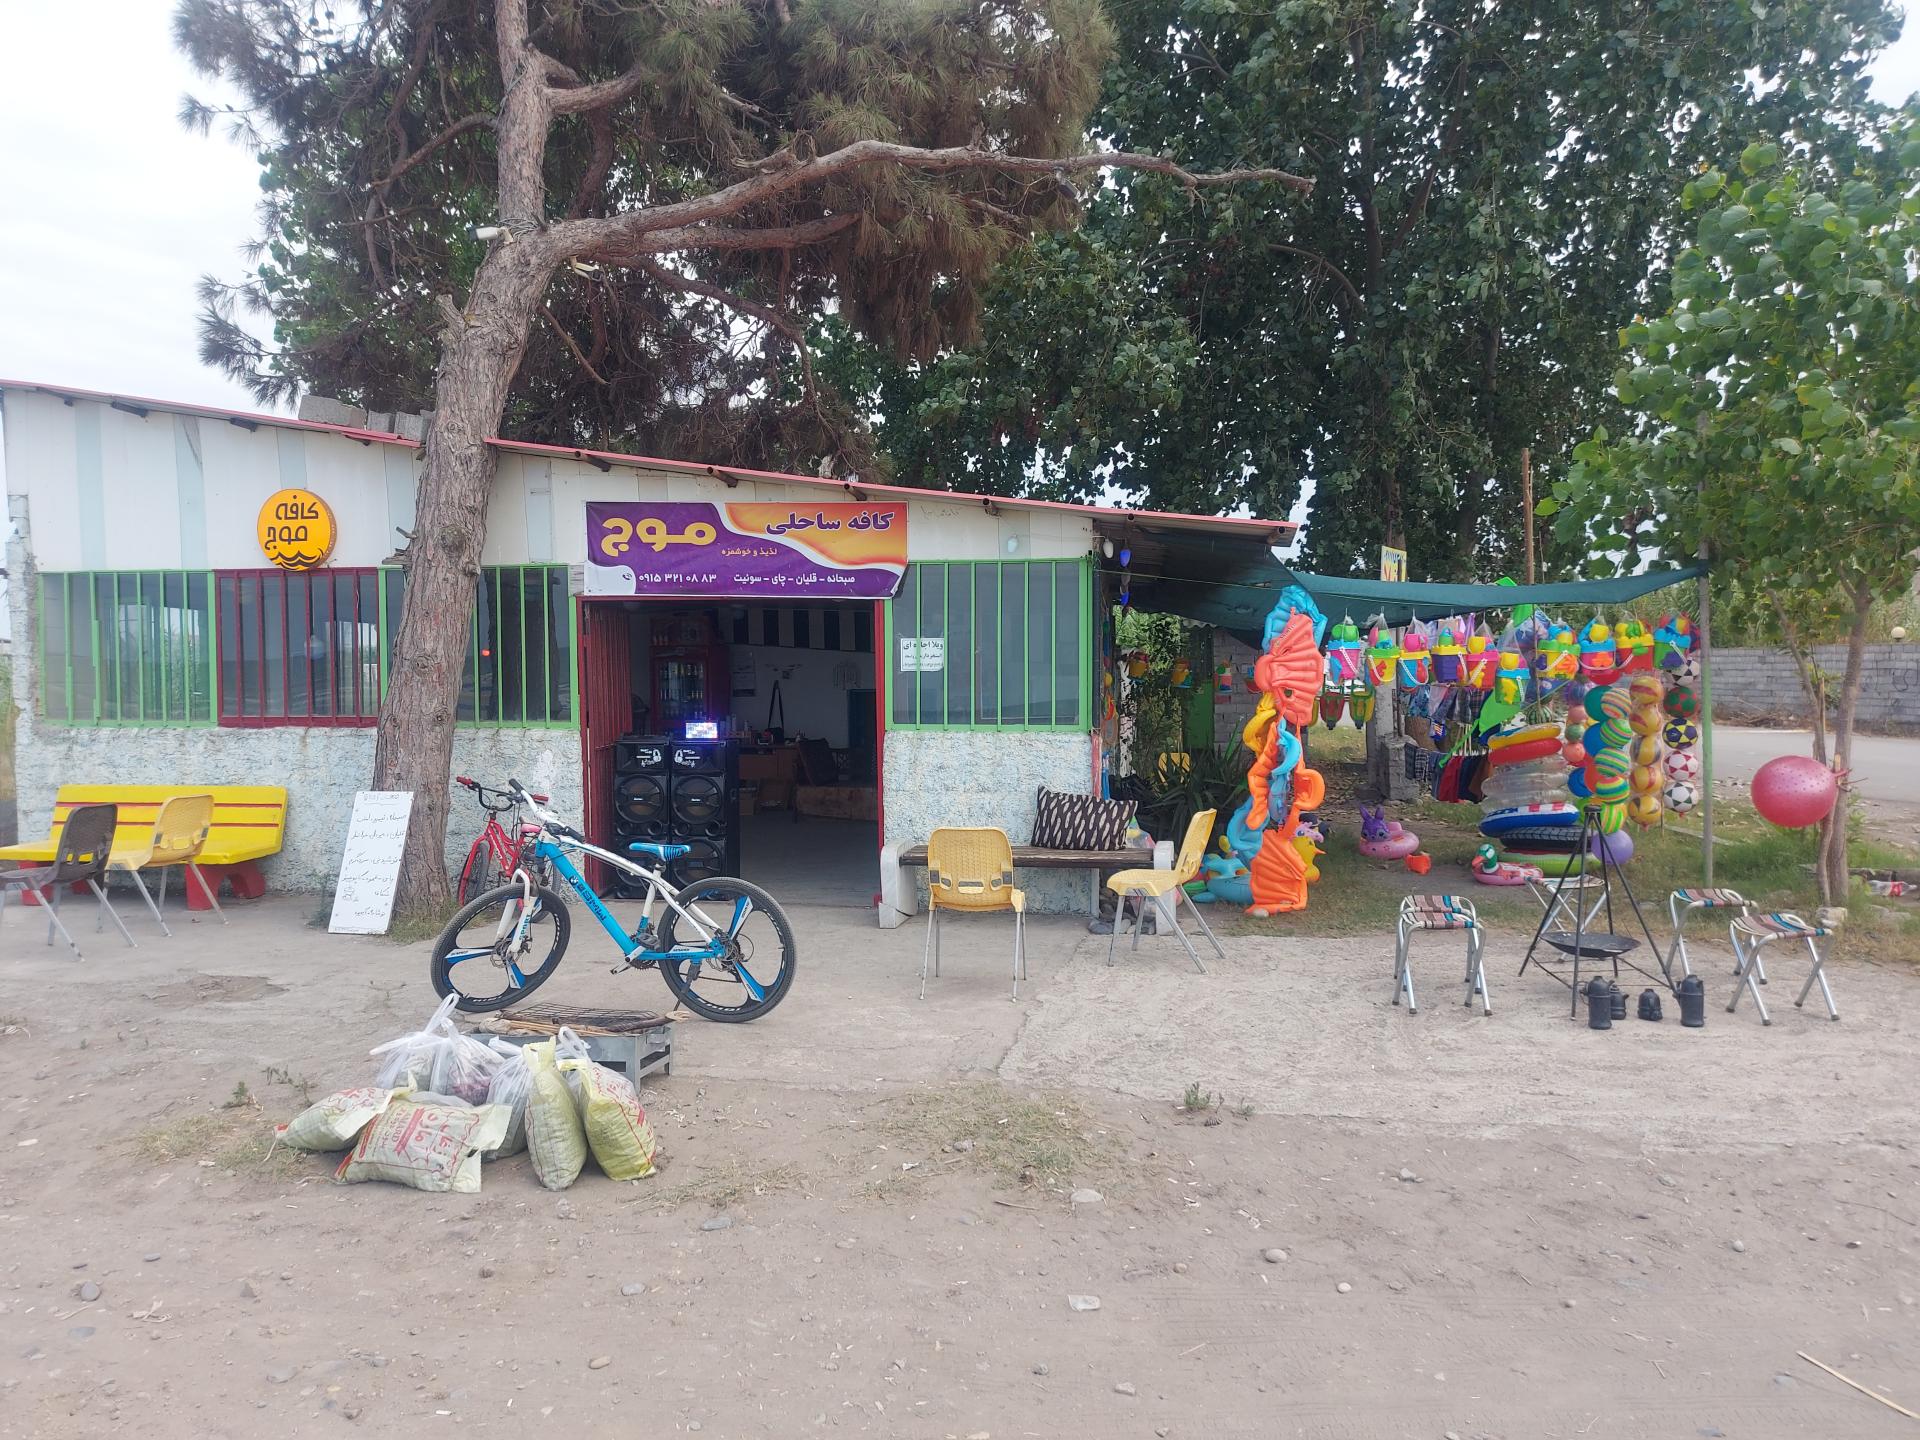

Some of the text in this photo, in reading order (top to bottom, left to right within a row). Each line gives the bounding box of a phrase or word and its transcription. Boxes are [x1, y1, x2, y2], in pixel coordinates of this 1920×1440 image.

[275, 495, 319, 520] کافه
[765, 511, 895, 535] کافه ساحلی
[264, 525, 308, 550] موج
[600, 518, 717, 557] موج
[721, 547, 751, 557] خوشمزه
[759, 547, 778, 557] لذیذ
[771, 573, 786, 587] چای
[795, 572, 817, 585] قلیان
[827, 573, 855, 586] صبحانه
[932, 641, 944, 650] ویلا
[519, 914, 531, 940] SPORT
